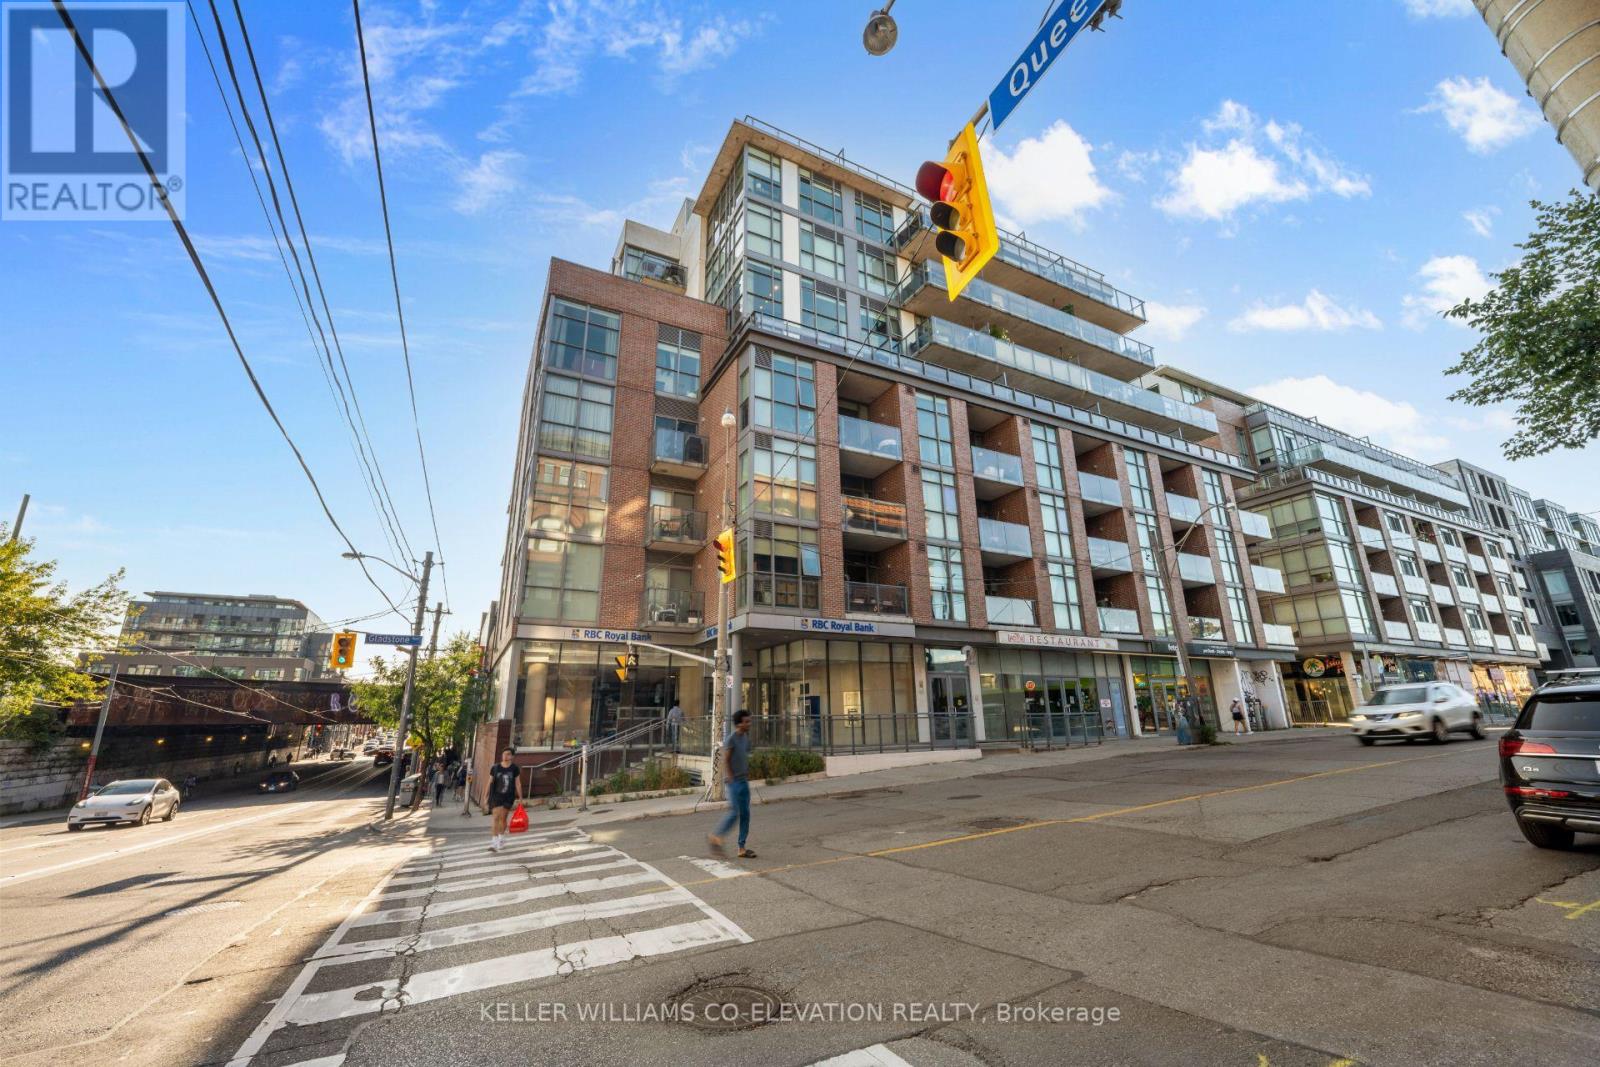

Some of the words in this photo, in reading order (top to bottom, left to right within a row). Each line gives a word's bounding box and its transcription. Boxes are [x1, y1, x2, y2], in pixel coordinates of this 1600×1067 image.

[812, 619, 829, 630] RBC
[831, 621, 852, 633] Royal
[855, 622, 874, 632] Bank
[368, 634, 410, 643] Gladstone
[584, 629, 602, 639] RBC
[604, 630, 628, 641] Royal
[631, 631, 652, 641] Bank
[1029, 635, 1100, 648] RESTAURANT
